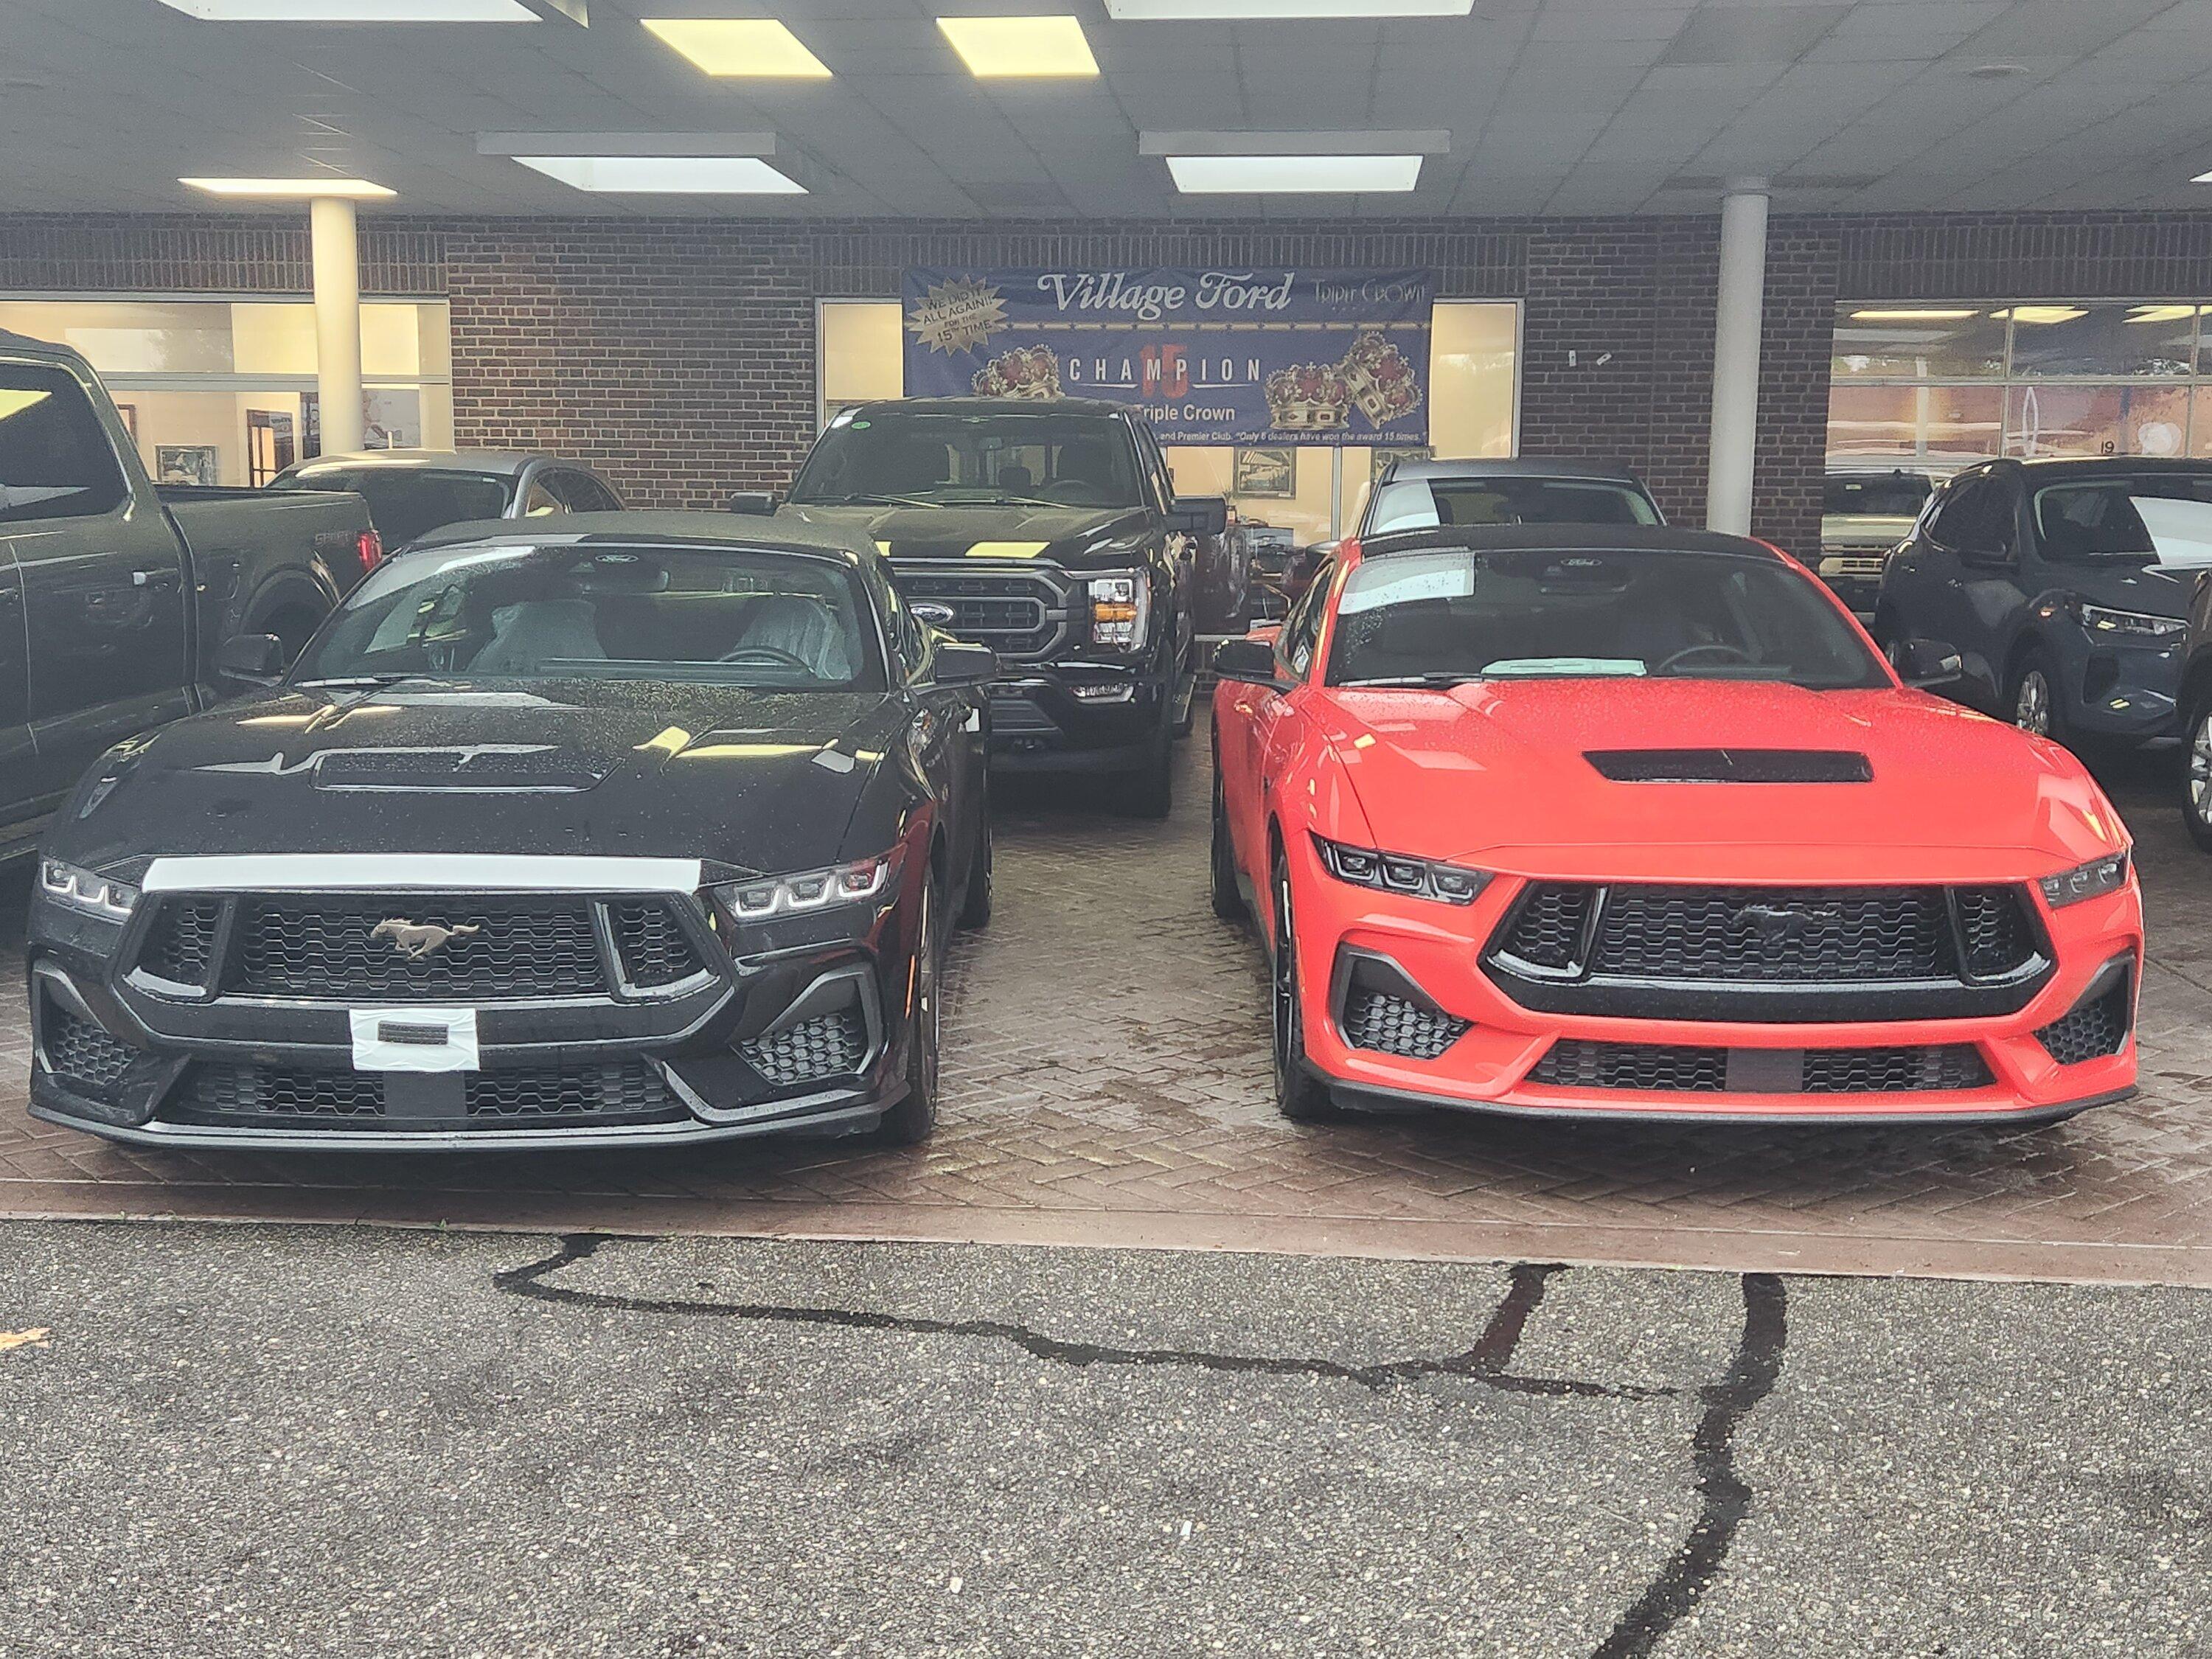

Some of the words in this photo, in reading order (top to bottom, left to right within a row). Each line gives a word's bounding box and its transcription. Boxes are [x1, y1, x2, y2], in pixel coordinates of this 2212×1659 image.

[927, 299, 947, 310] WE
[948, 292, 969, 304] DID
[972, 288, 981, 298] IT
[1037, 272, 1186, 320] Village
[1195, 272, 1295, 310] Ford
[923, 311, 947, 324] ALL
[944, 319, 960, 328] FOR
[961, 313, 978, 323] THE
[962, 319, 992, 335] TIME
[1069, 358, 1260, 381] CHAMPION
[1140, 343, 1189, 400] 15
[1141, 403, 1179, 424] riple
[1183, 404, 1235, 421] Crown
[1161, 432, 1176, 441] and
[1178, 431, 1210, 441] Premier
[1267, 432, 1298, 441] dealers
[1300, 431, 1321, 441] have
[1323, 433, 1340, 441] won
[1342, 431, 1355, 441] the
[1357, 431, 1383, 441] award
[1385, 431, 1394, 441] 15
[2101, 440, 2115, 454] 19
